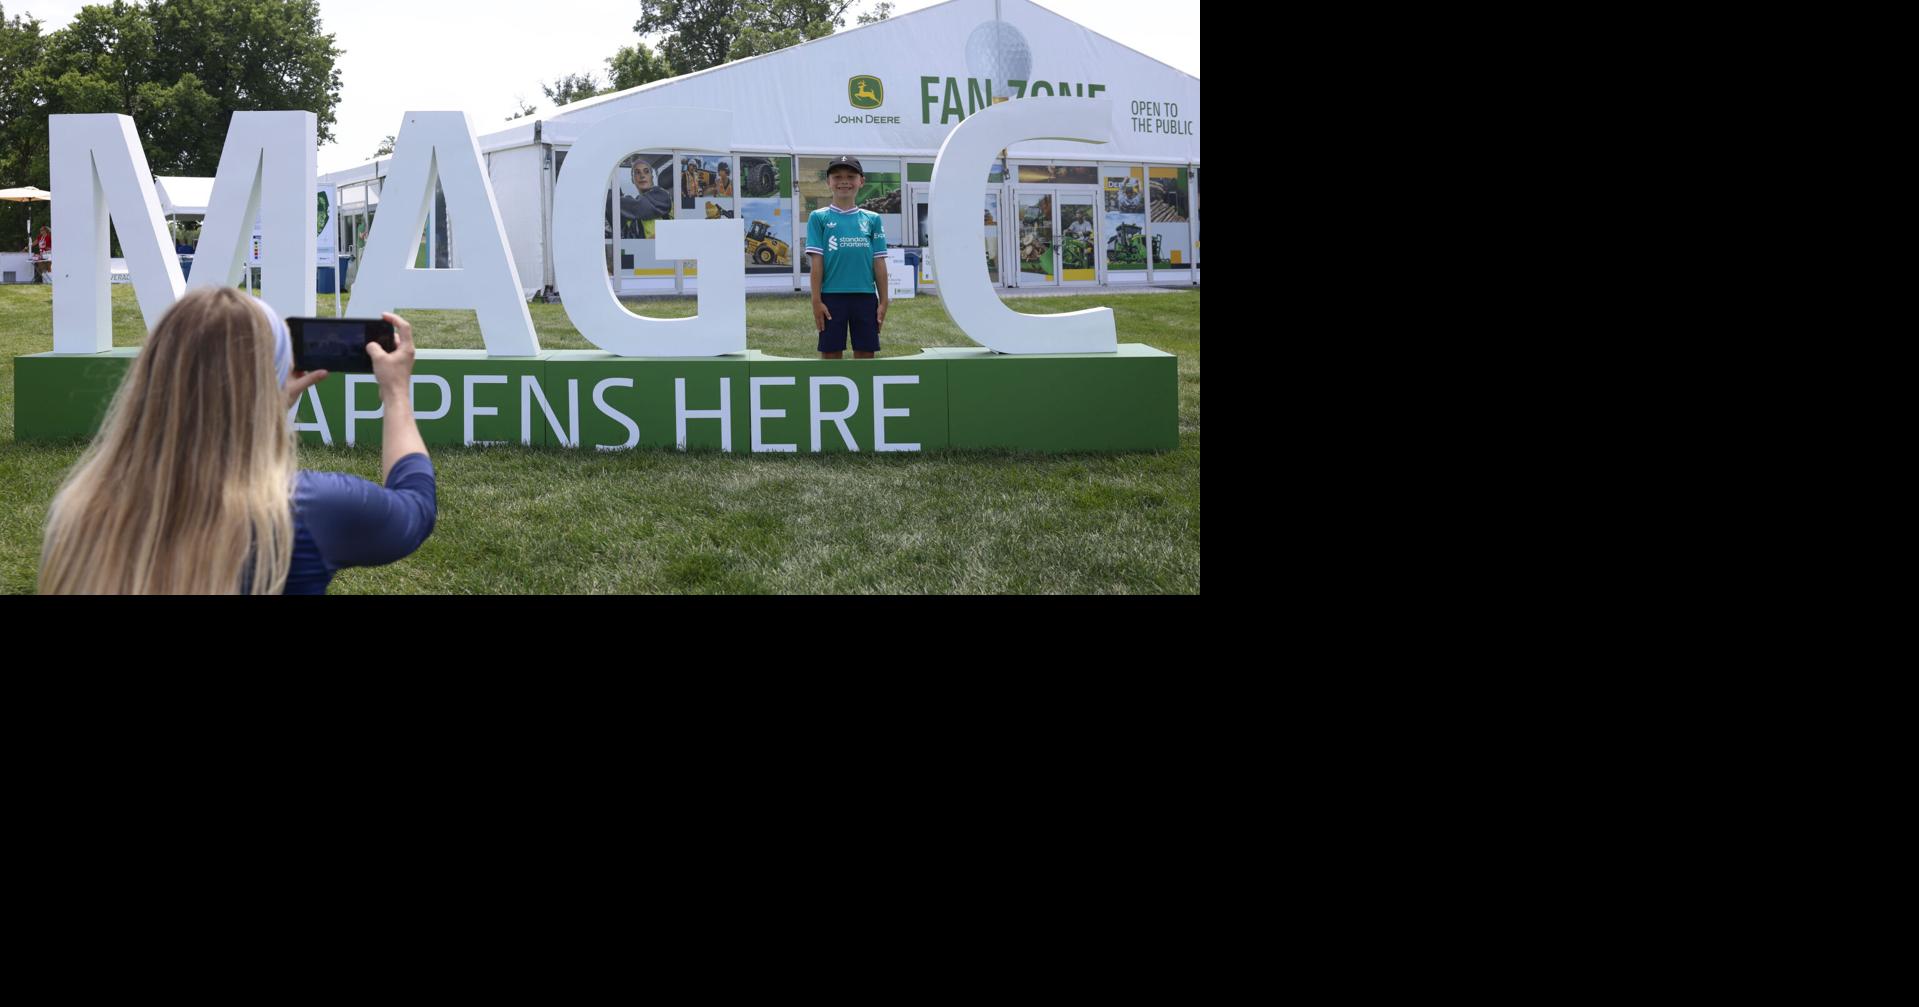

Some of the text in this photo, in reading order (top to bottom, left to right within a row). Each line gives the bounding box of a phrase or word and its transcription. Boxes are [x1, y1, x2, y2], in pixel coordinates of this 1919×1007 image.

[920, 76, 993, 125] FAN
[1131, 100, 1178, 118] OPEN TO
[834, 114, 901, 124] JOHN DEERE
[1131, 117, 1193, 136] THE PUBLIC
[287, 373, 921, 452] APPENS HERE
